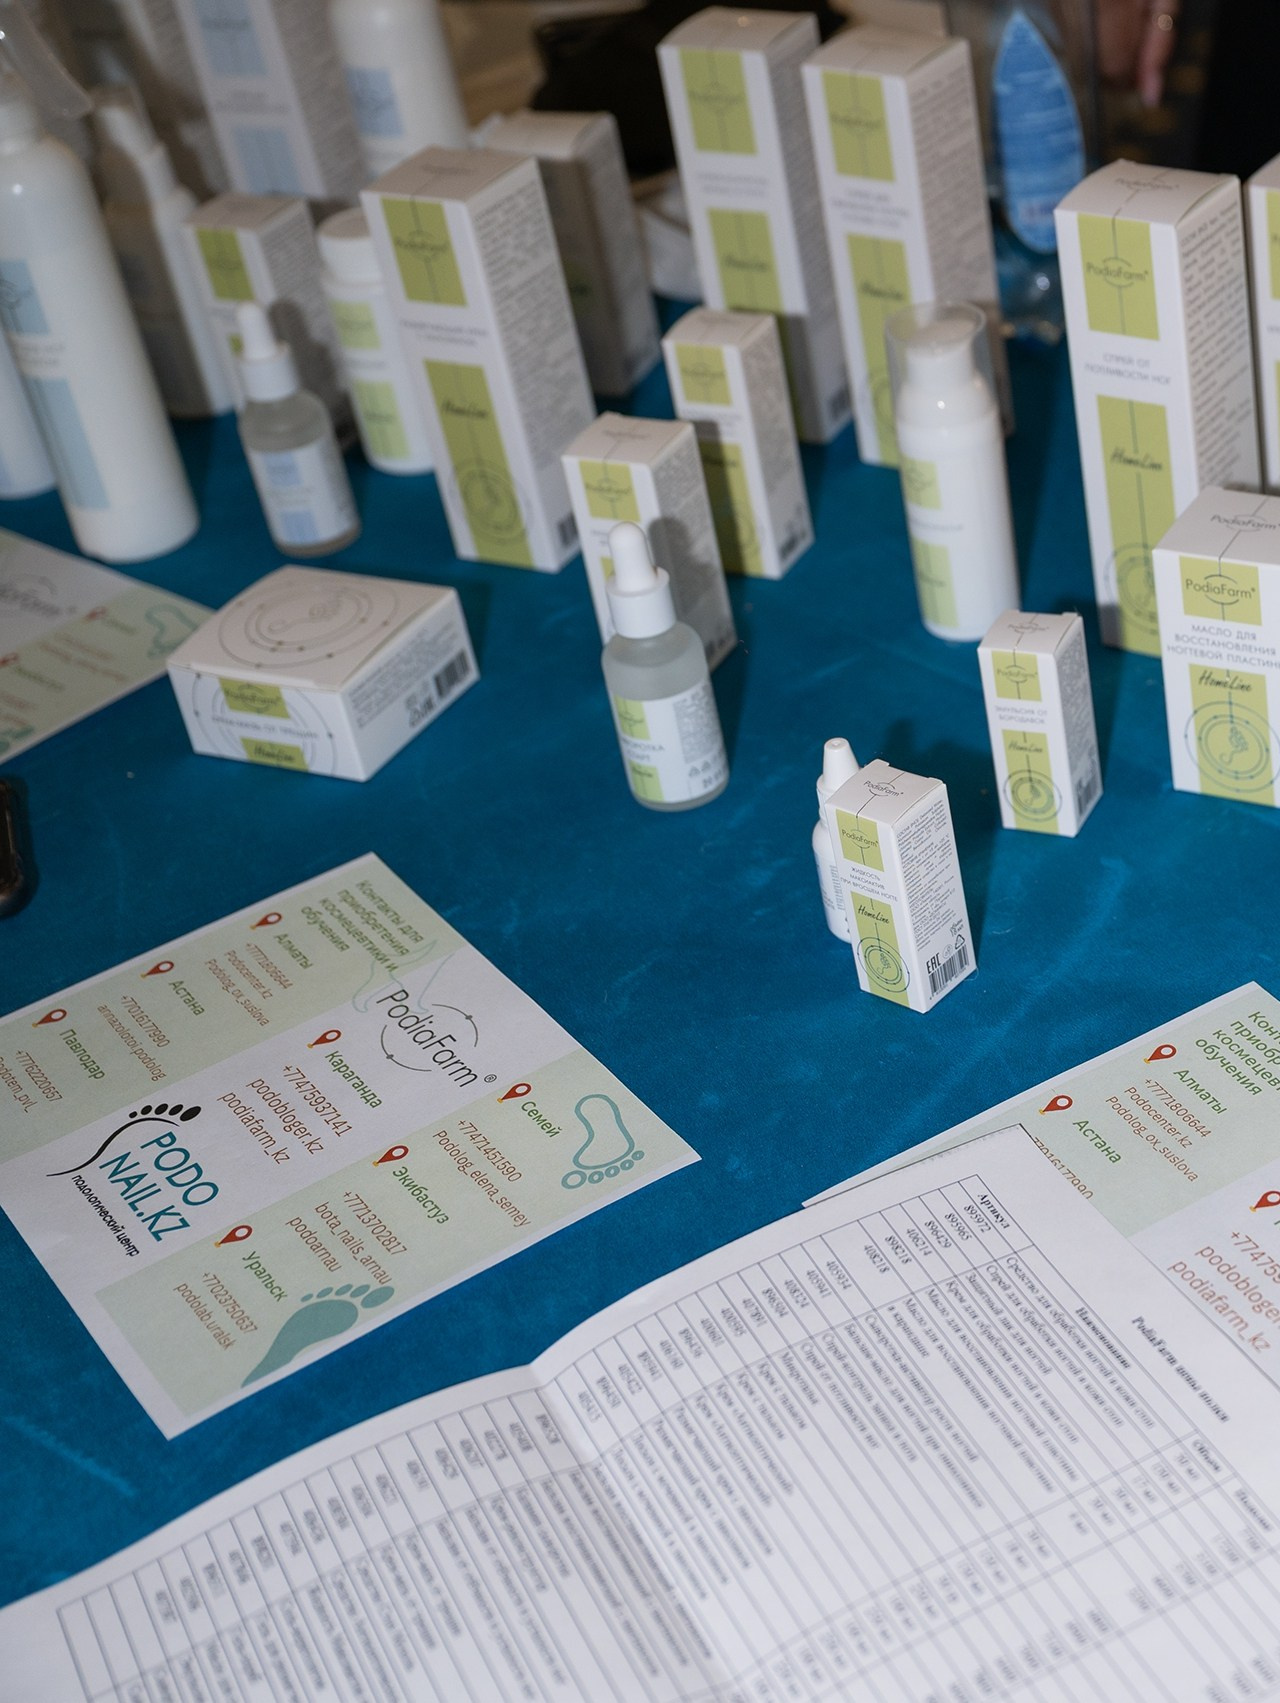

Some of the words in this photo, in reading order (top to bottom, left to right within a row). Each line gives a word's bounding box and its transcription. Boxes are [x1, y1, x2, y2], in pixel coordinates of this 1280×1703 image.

[1166, 645, 1224, 662] НОГТЕВОЙ
[1174, 633, 1277, 657] ВОССТАНОВЛЕНИЯ
[1191, 624, 1232, 639] МАСЛО
[1236, 630, 1257, 642] ДЛЯ
[301, 906, 350, 952] обучения
[319, 897, 391, 964] космецевтики
[338, 889, 410, 956] приобретения
[356, 880, 405, 926] Контакты
[398, 925, 424, 943] для
[274, 933, 314, 969] Алматы
[168, 979, 205, 1016] Астана
[59, 1028, 105, 1080] Павлодар
[325, 1050, 382, 1109] Караганда
[1195, 1039, 1263, 1096] обучения
[247, 1076, 324, 1155] podobloger.kz
[282, 1064, 353, 1137] +77475937141
[520, 1100, 561, 1139] Семей
[1124, 1086, 1193, 1149] Podocenter.kz
[1145, 1078, 1212, 1138] +77771806644
[1173, 1069, 1227, 1114] Алматы
[218, 1091, 291, 1165] podiafarm_kz
[457, 1119, 522, 1183] +77471451590
[1072, 1119, 1122, 1163] Астана
[1105, 1095, 1198, 1182] Podolog_ox_suslova
[99, 1151, 190, 1243] NAIL.KZ
[139, 1131, 219, 1207] PODO
[392, 1166, 450, 1226] Экибастуз
[432, 1129, 532, 1229] Podolog_elena_semey
[72, 1175, 125, 1235] подологический
[116, 1232, 140, 1257] центр
[285, 1217, 342, 1273] podoarnau
[313, 1202, 394, 1286] bota_nails_arnau
[342, 1191, 407, 1256] +77713702817
[201, 1271, 258, 1335] +77023750637
[242, 1251, 289, 1302] Уральск
[1167, 1260, 1271, 1353] podiafarm_kz
[173, 1282, 236, 1352] podolab.uralsk
